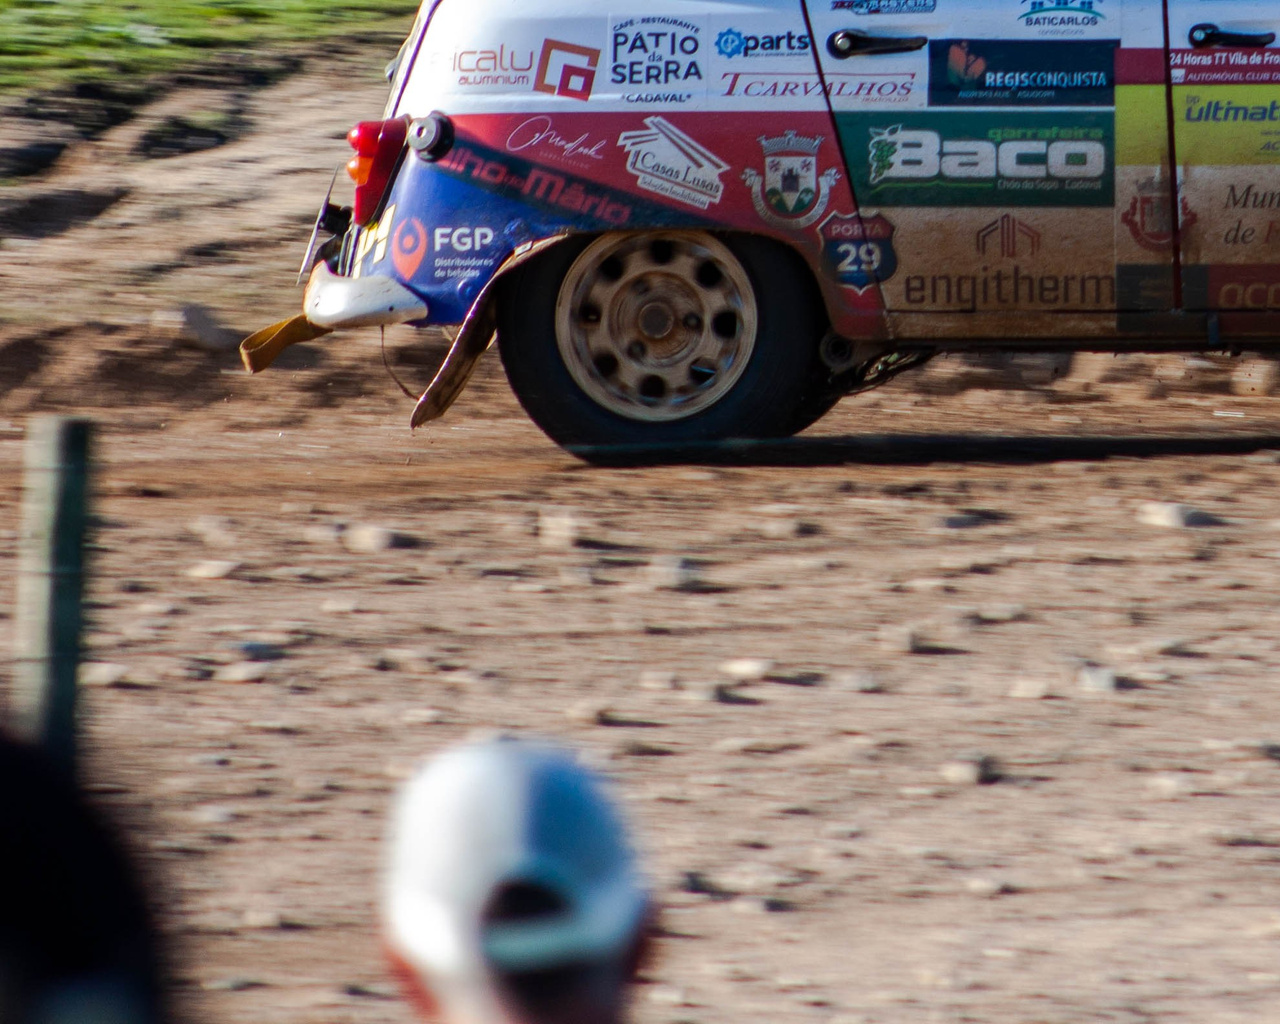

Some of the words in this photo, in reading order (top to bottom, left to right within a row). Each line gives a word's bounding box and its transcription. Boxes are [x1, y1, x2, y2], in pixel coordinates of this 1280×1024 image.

[1025, 16, 1098, 26] BATICARLOS
[613, 31, 699, 64] PÁTIO
[647, 51, 662, 62] da
[1183, 53, 1212, 65] Horas
[1214, 52, 1227, 64] TT
[1228, 51, 1248, 64] Vila
[1250, 52, 1261, 64] de
[611, 60, 703, 85] SERRA
[884, 129, 1105, 179] Baco
[640, 151, 680, 179] Casas
[683, 167, 722, 195] Lusas
[434, 227, 494, 252] FGP
[1223, 220, 1255, 246] de
[836, 242, 882, 272] 29
[904, 265, 1116, 313] engitherm
